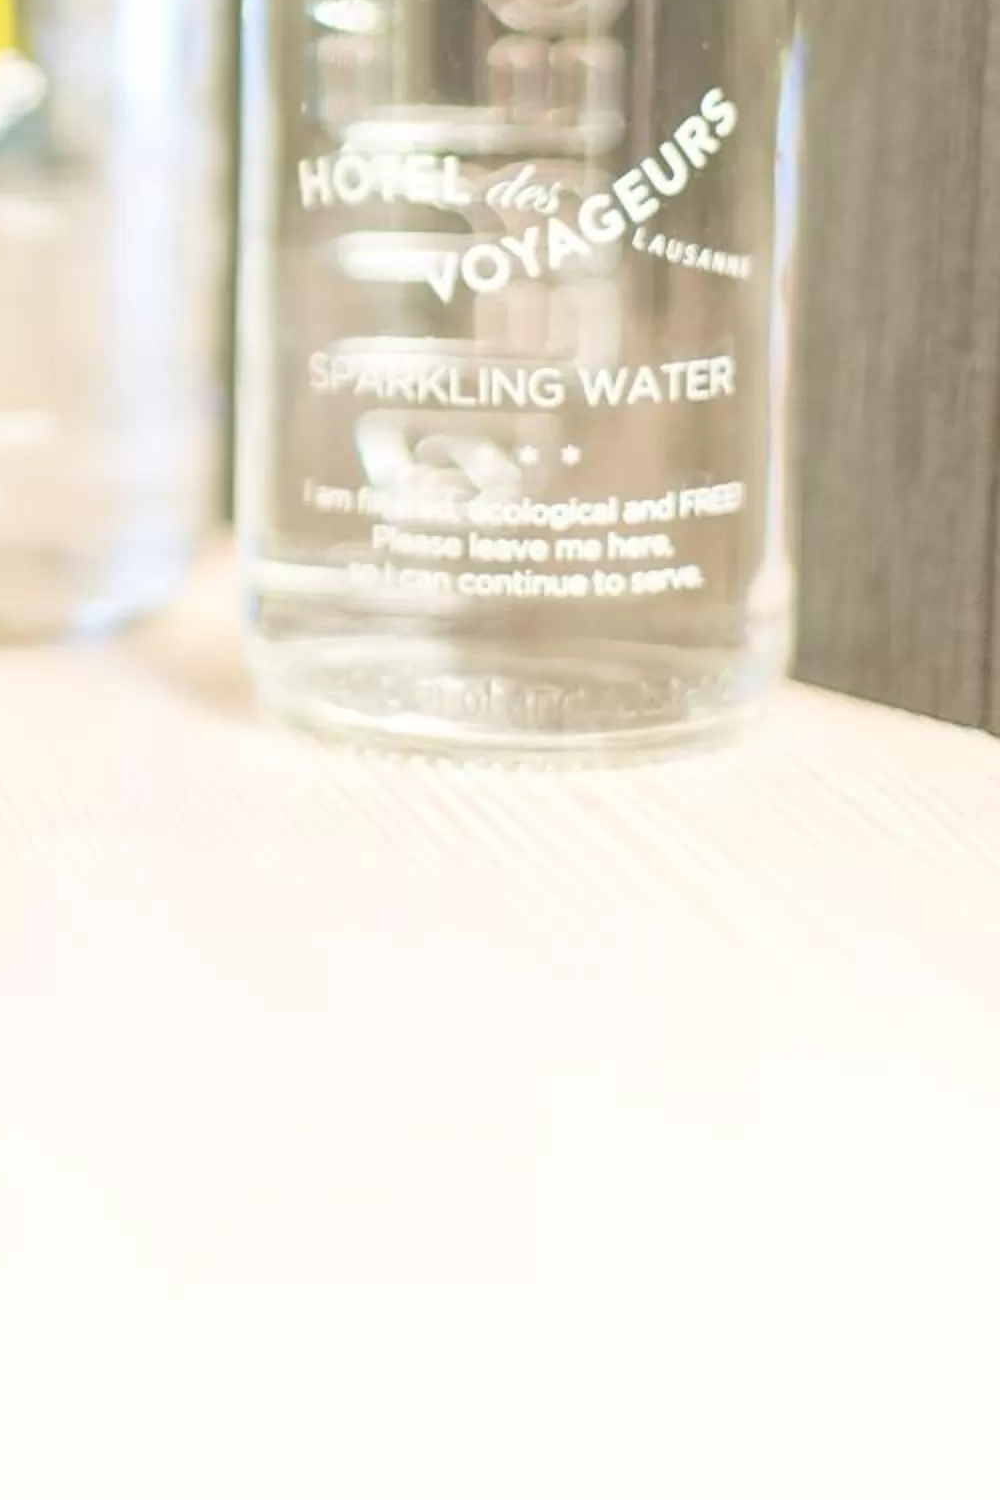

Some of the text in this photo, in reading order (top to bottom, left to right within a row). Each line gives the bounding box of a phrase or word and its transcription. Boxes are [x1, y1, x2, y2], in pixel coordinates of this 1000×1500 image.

[299, 143, 561, 215] HÔTEL des
[426, 87, 737, 303] VOYAGEURS
[631, 227, 753, 280] LAUSANNE
[308, 351, 736, 408] SPARKLING WATER
[315, 484, 352, 513] am
[468, 495, 619, 531] ecological
[623, 491, 676, 524] and
[371, 525, 463, 561] Please
[469, 531, 549, 562] leave
[554, 538, 602, 562] me
[398, 568, 451, 594] can
[457, 569, 588, 597] continue
[592, 569, 627, 596] to
